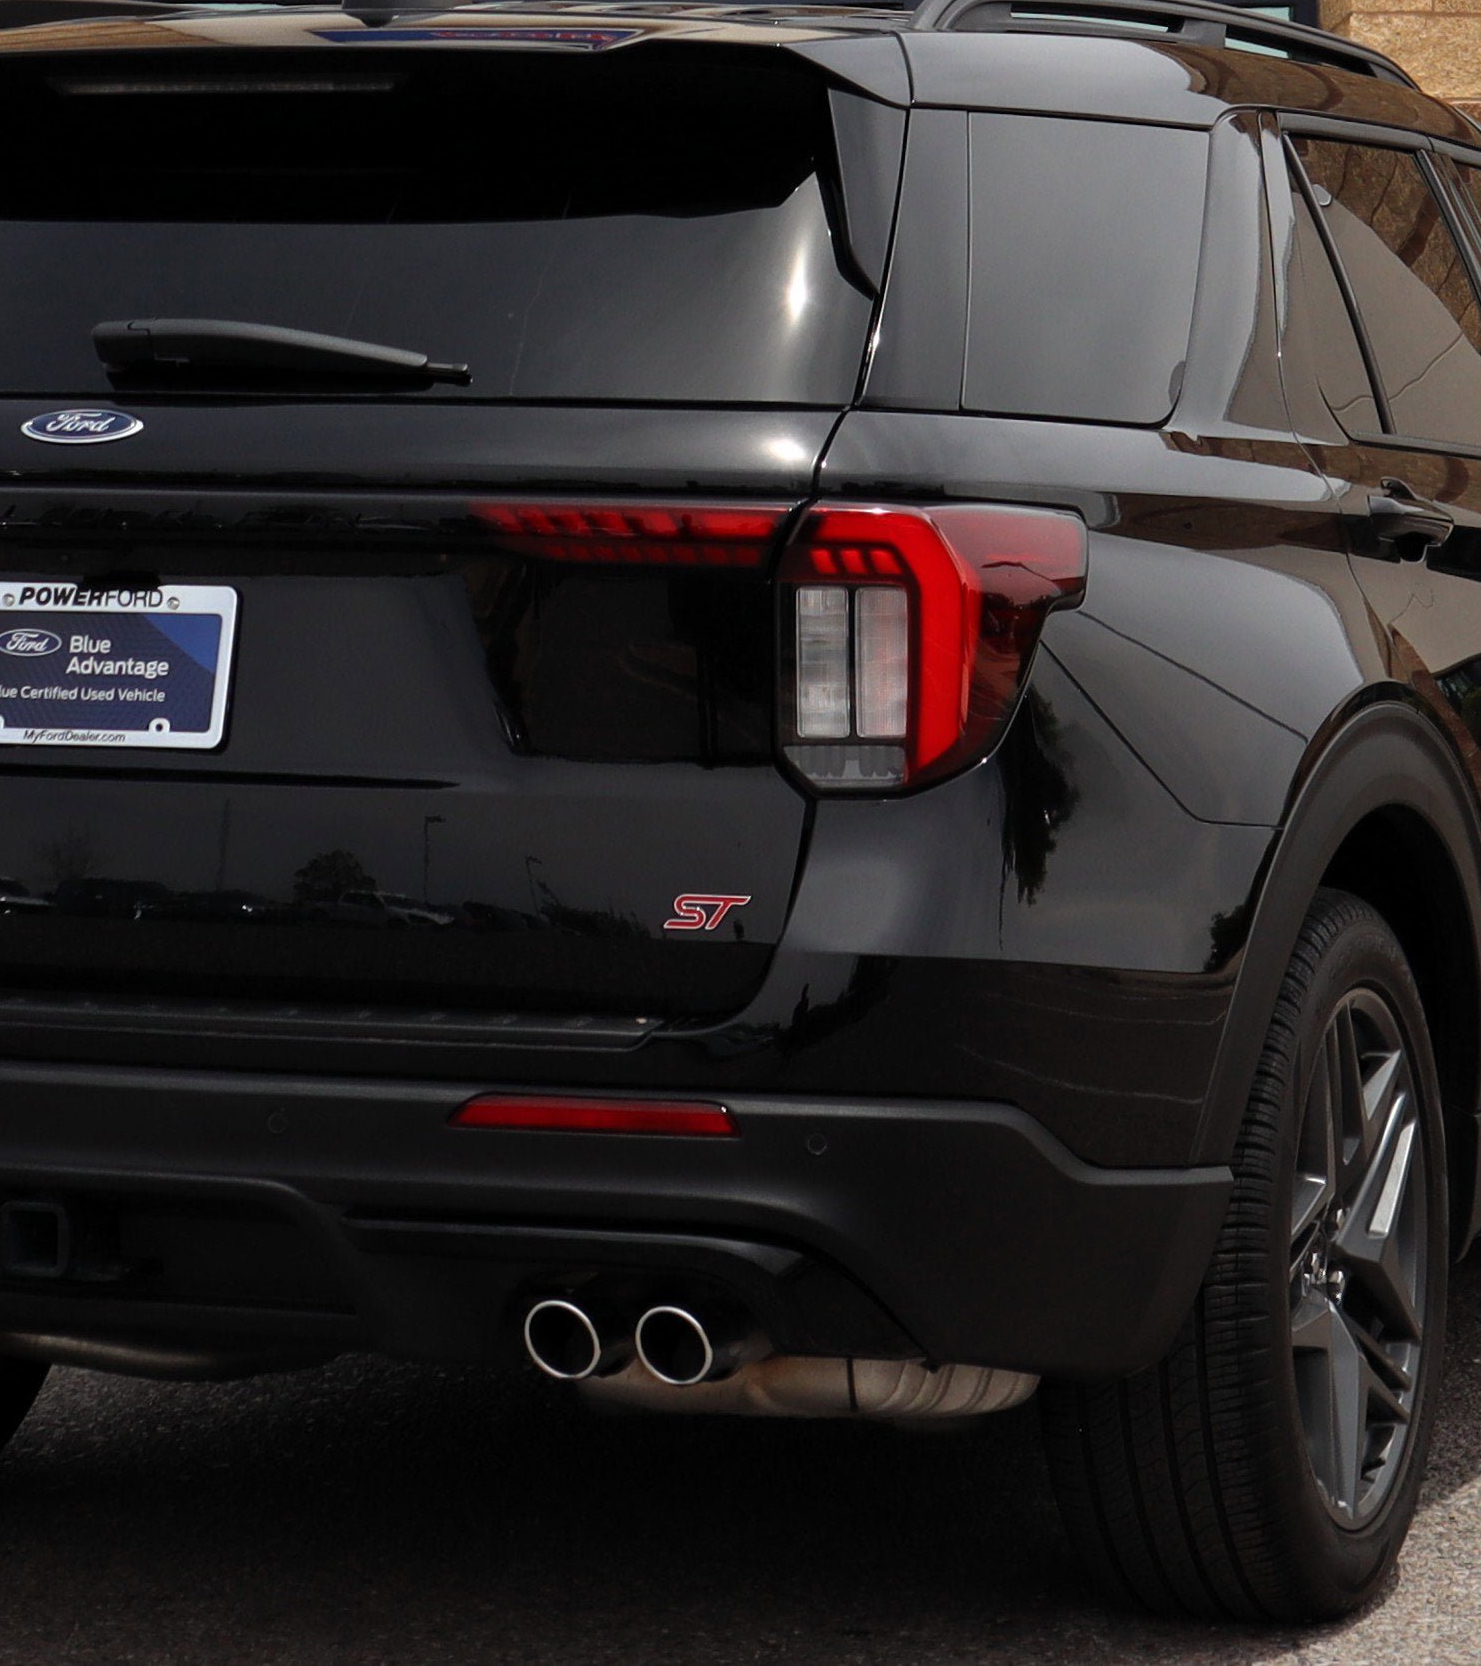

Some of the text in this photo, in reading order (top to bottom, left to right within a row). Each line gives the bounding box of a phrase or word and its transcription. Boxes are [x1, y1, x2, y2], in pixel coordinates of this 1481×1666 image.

[46, 412, 116, 432] Ford
[19, 586, 164, 608] POWERFORD
[6, 632, 50, 652] Ford
[69, 635, 112, 654] Blue
[65, 656, 170, 679] Advantage
[20, 685, 78, 701] Certified
[80, 687, 115, 701] Used
[117, 688, 166, 703] Vehicle
[23, 729, 126, 744] MyFordDealer.com
[663, 893, 752, 930] ST
